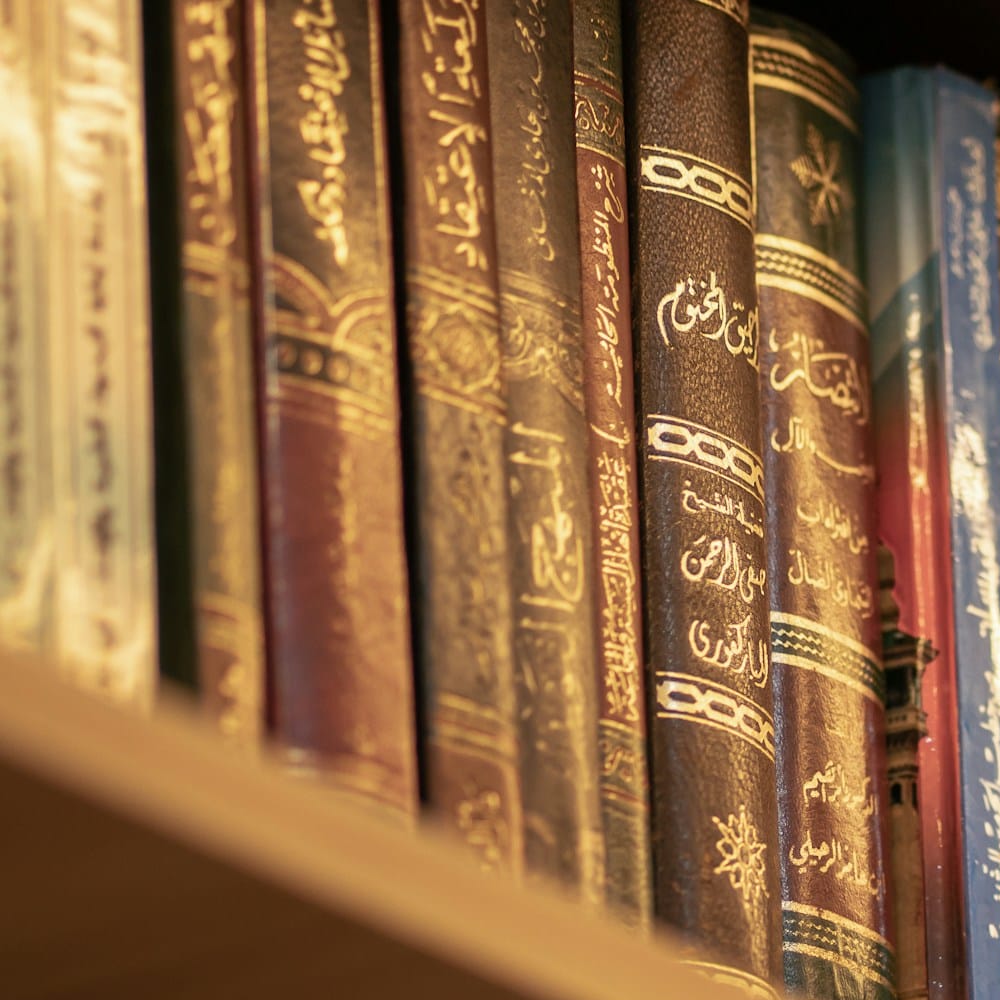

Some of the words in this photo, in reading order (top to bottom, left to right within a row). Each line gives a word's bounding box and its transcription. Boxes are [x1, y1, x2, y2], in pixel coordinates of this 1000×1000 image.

[590, 164, 625, 224] شرح
[592, 210, 621, 312] المنظومة
[656, 269, 728, 348] المختوم
[681, 480, 734, 515] الشيخ
[680, 534, 741, 590] الرحمن
